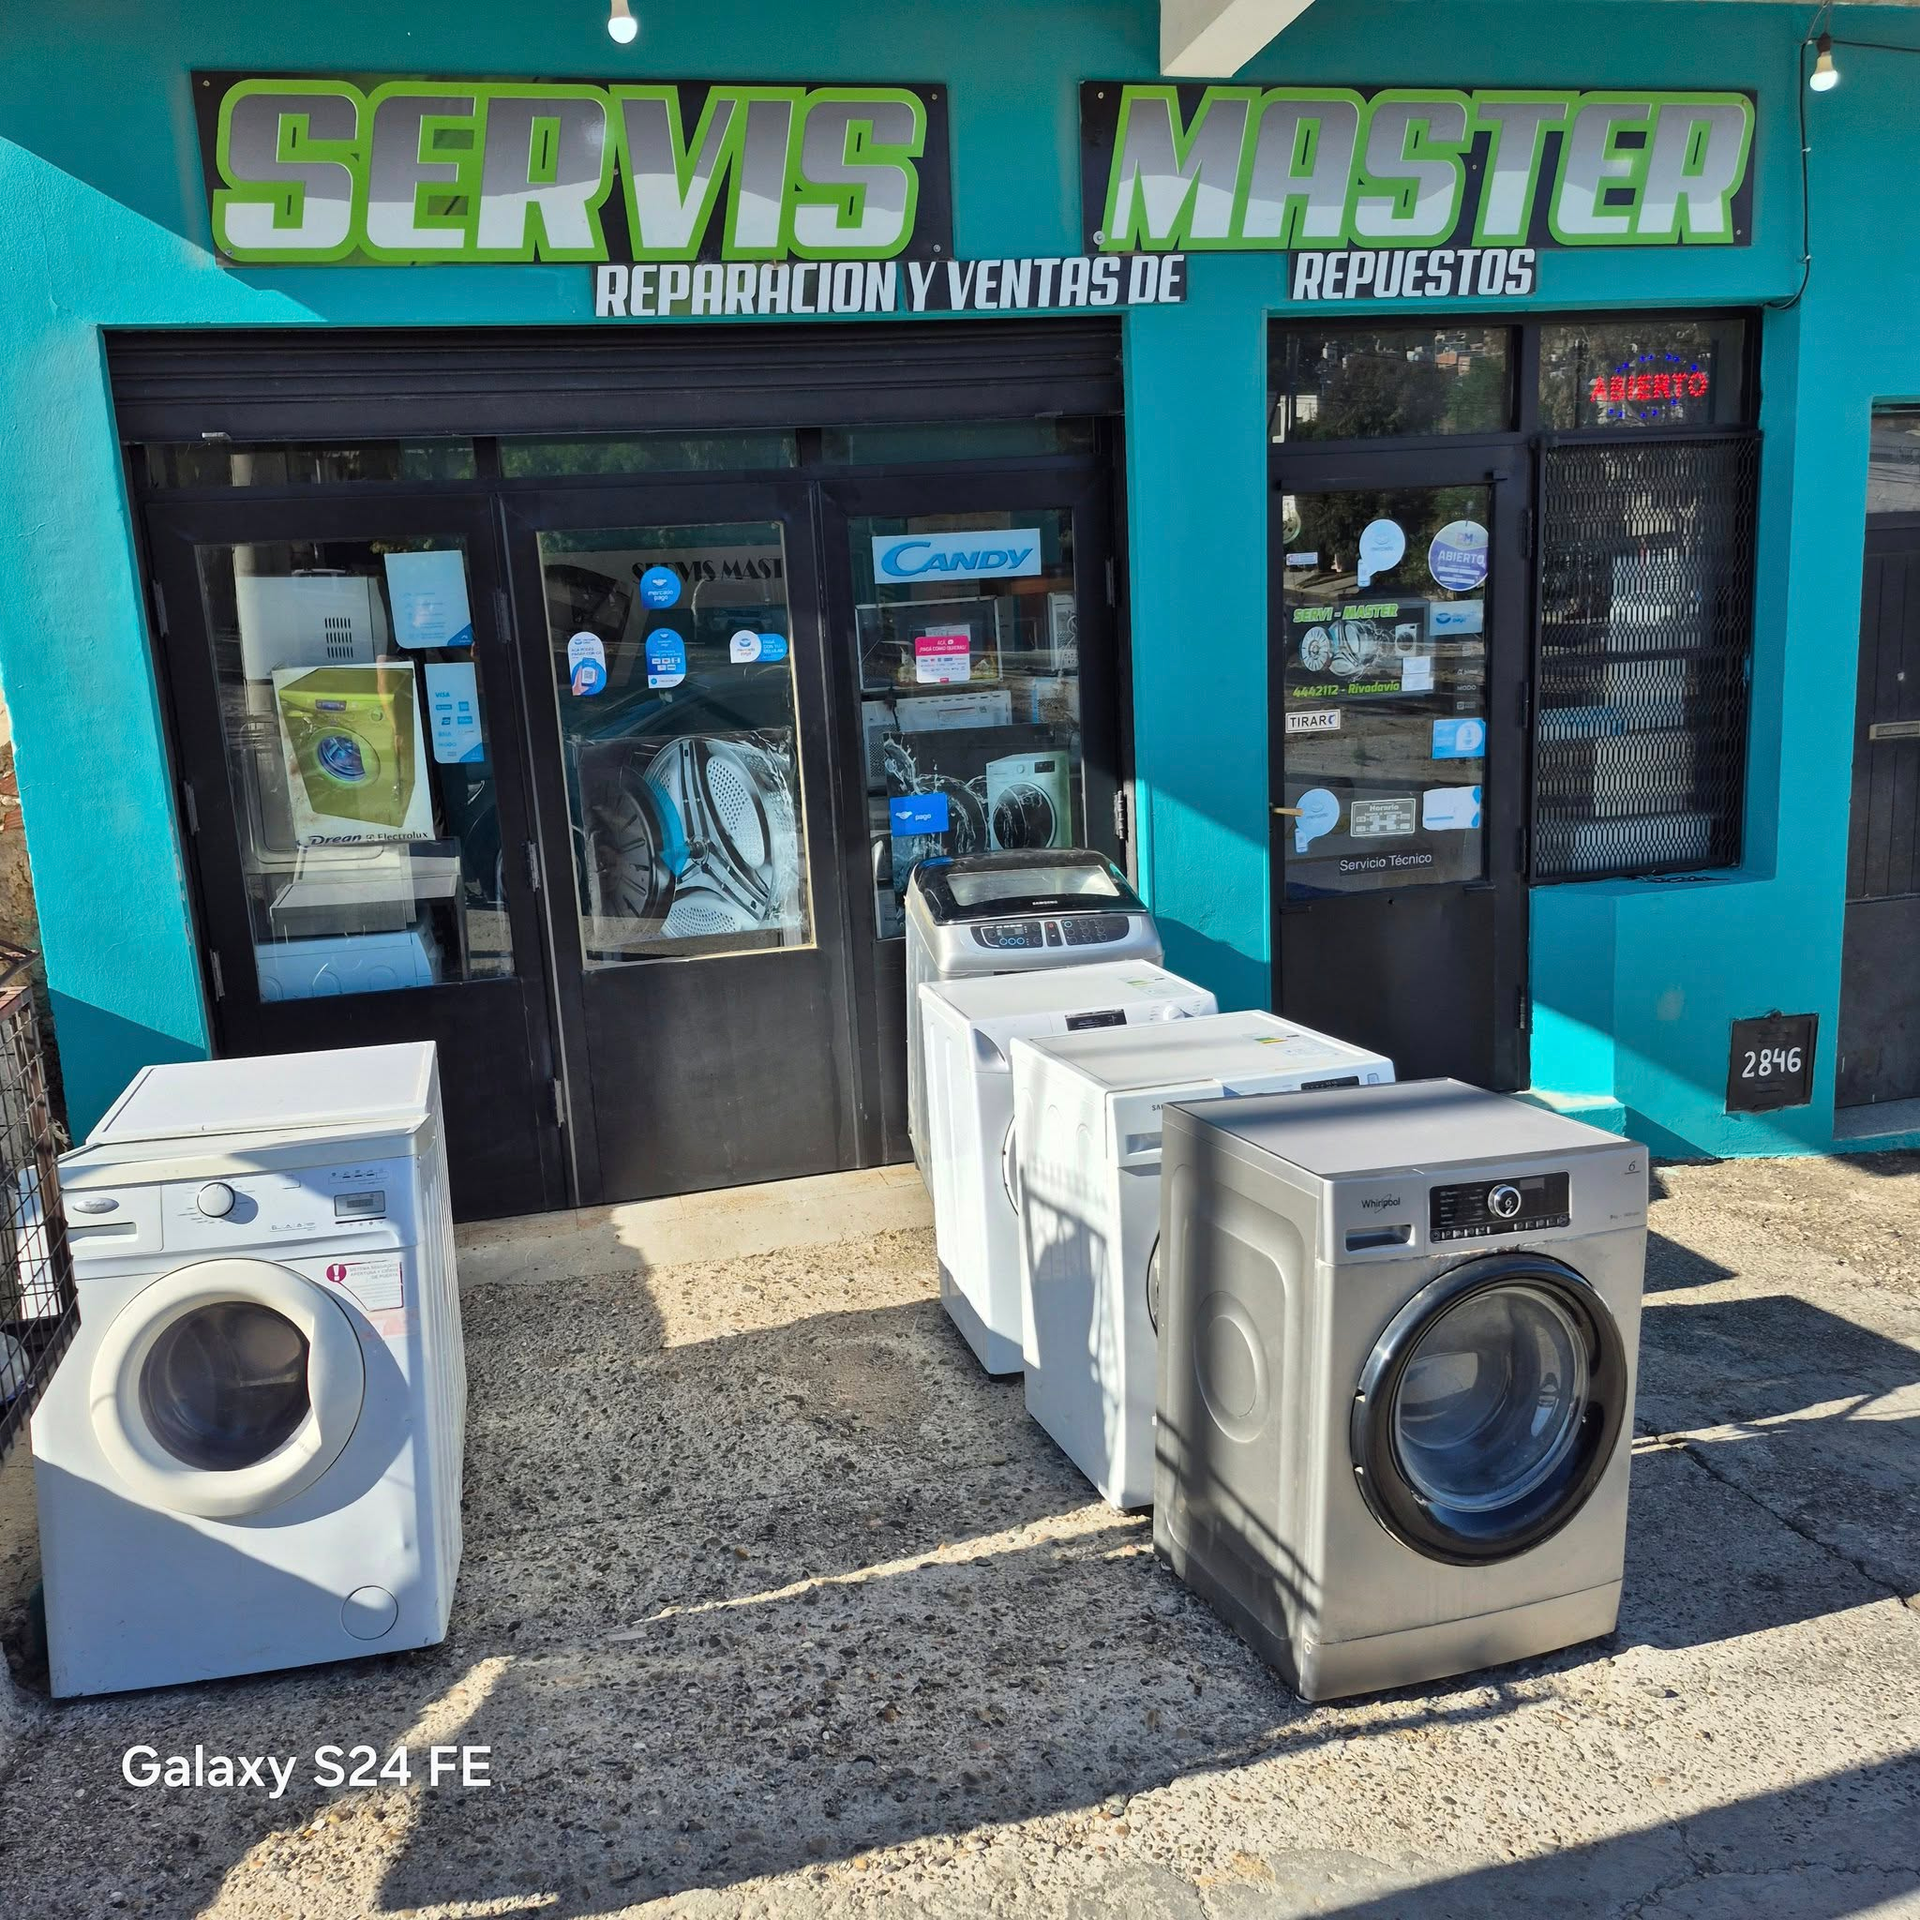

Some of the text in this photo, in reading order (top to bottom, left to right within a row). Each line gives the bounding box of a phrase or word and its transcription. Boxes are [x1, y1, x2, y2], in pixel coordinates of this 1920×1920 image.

[212, 79, 1755, 264] SERVIS MASTER
[595, 249, 1536, 317] REPARACION Y VENTAS DE REPUESTOS
[1589, 371, 1710, 403] ABIERTO
[881, 541, 1033, 576] CANDY
[632, 558, 716, 582] SVIS
[1293, 607, 1333, 623] SERVI
[1342, 604, 1398, 620] MASTER
[1293, 685, 1339, 698] 4442112
[1290, 714, 1327, 728] TIRAR
[915, 813, 932, 821] pago
[1369, 804, 1399, 812] Horario
[308, 834, 362, 846] Drean
[1340, 852, 1432, 872] Servicio Técnico
[1741, 1046, 1802, 1079] 2846
[1361, 1195, 1401, 1211] Whirlpool
